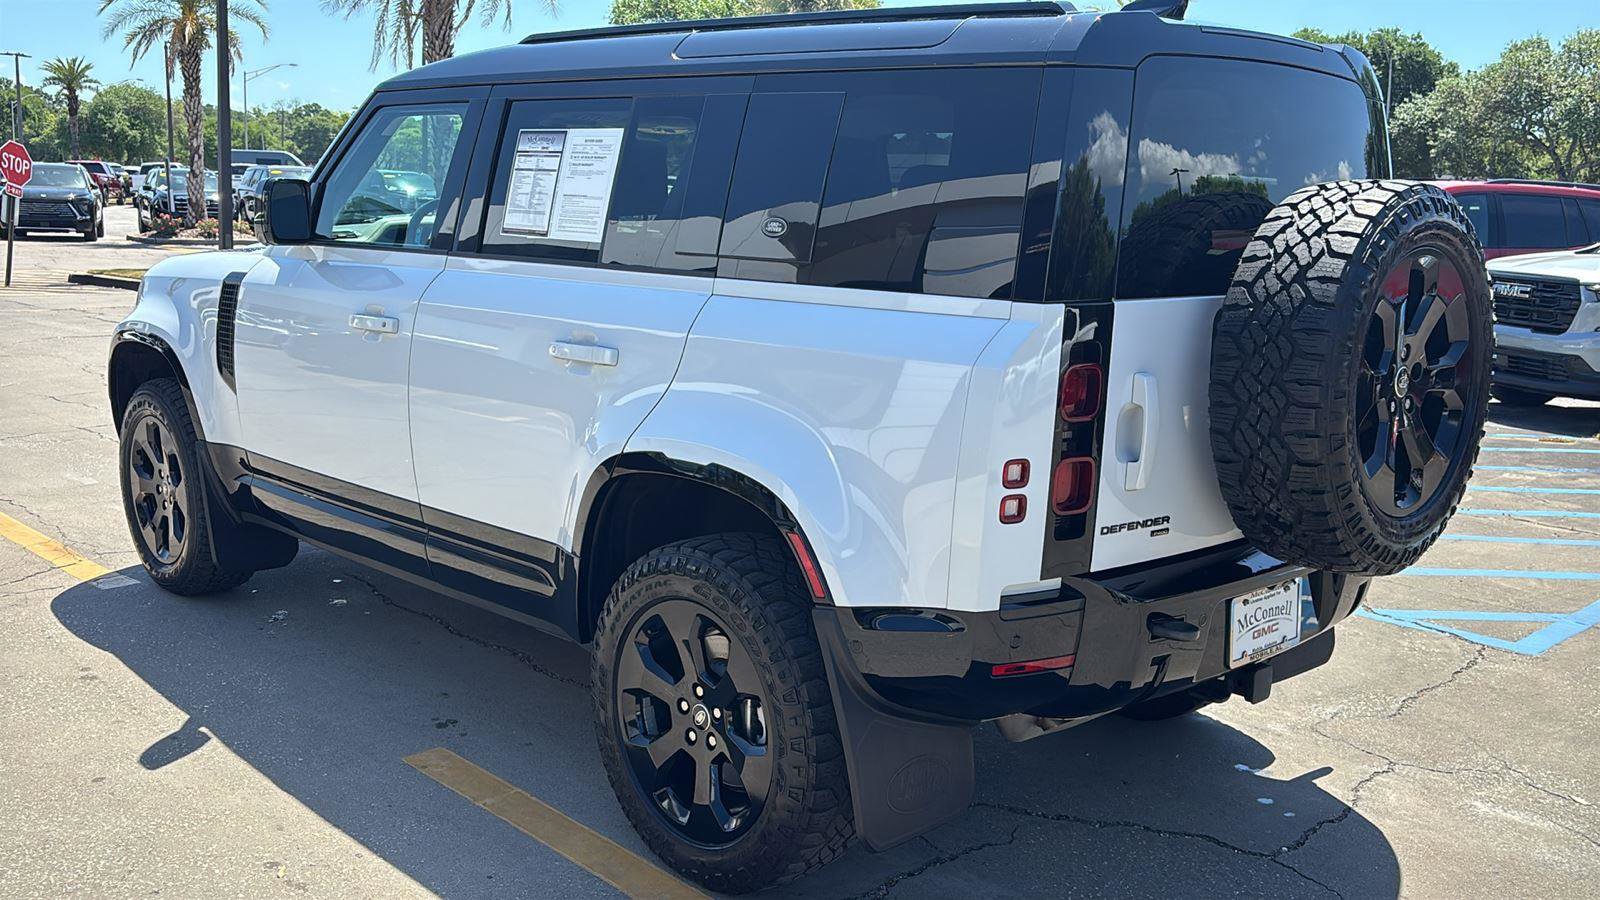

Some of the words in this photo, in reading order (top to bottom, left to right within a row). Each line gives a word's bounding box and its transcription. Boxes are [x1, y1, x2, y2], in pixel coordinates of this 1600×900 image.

[2, 152, 30, 175] STOP
[1100, 515, 1171, 536] DEFENDER
[1237, 600, 1293, 634] McConnell
[1252, 622, 1280, 640] GMC
